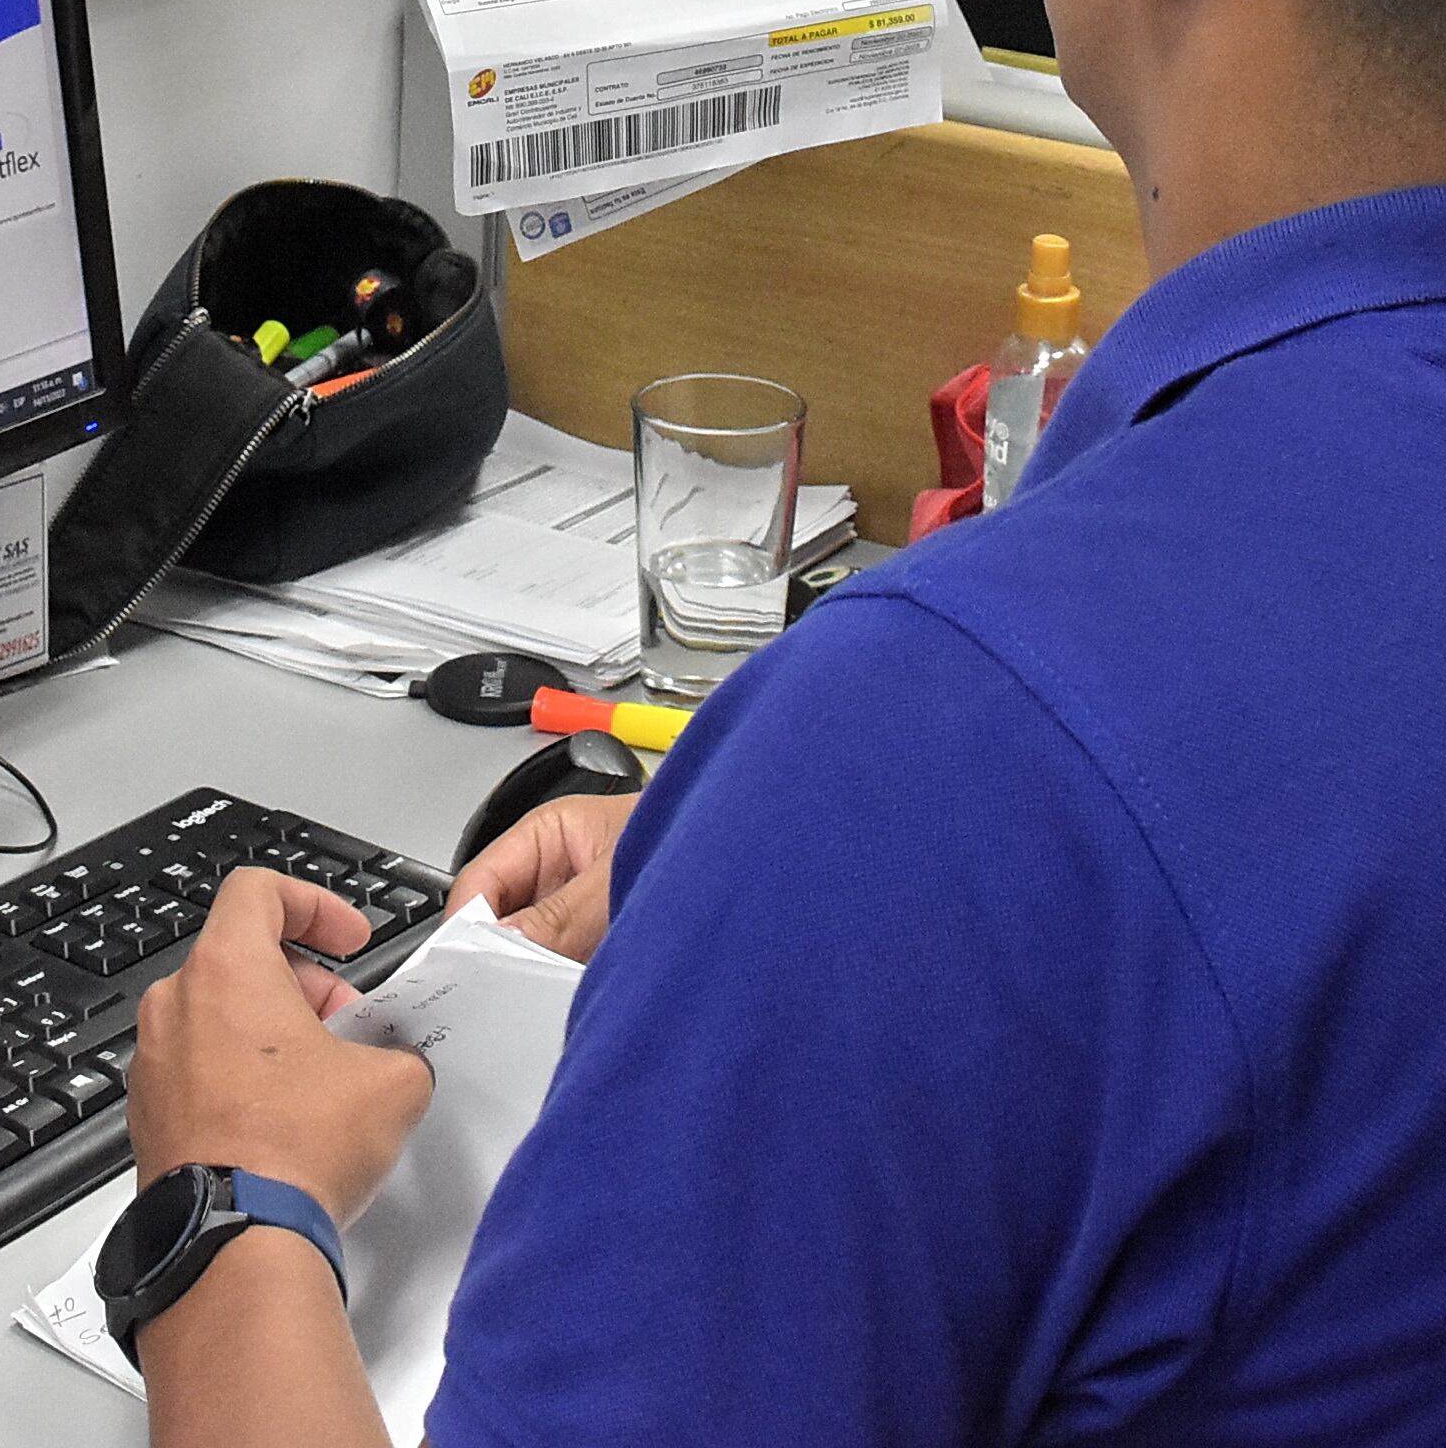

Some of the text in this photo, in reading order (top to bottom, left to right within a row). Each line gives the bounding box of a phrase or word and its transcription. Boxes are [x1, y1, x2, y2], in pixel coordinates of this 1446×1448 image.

[772, 34, 800, 46] TOTAL
[809, 27, 838, 39] PAGAR
[504, 76, 580, 95] EMPRESAS MUNICIPALES
[595, 83, 629, 94] CONTRATO
[4, 537, 30, 560] SAS
[171, 799, 233, 829] logitech
